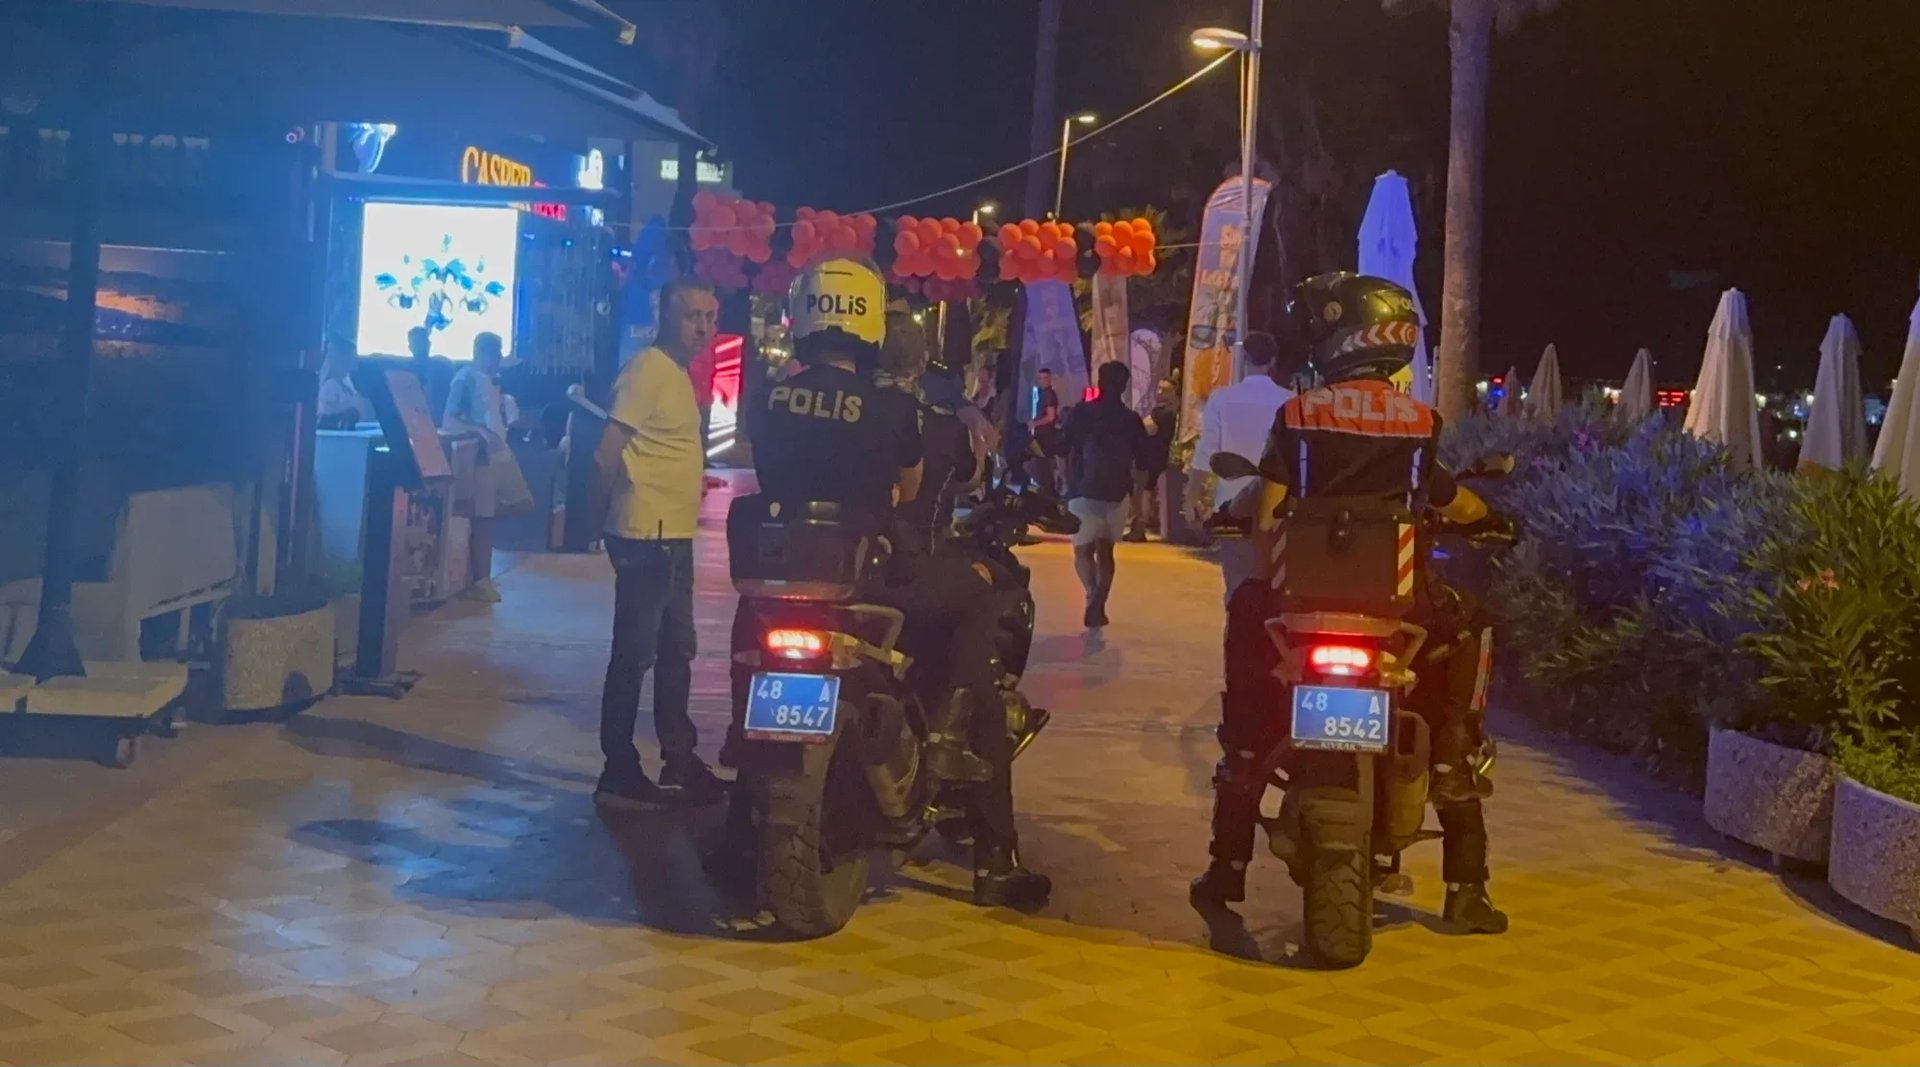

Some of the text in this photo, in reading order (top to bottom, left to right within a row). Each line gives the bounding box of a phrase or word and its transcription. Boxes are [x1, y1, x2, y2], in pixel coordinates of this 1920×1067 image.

[757, 679, 830, 703] 48 A
[1301, 691, 1380, 715] 48 A
[776, 705, 829, 727] 8547
[1324, 716, 1381, 739] 8542
